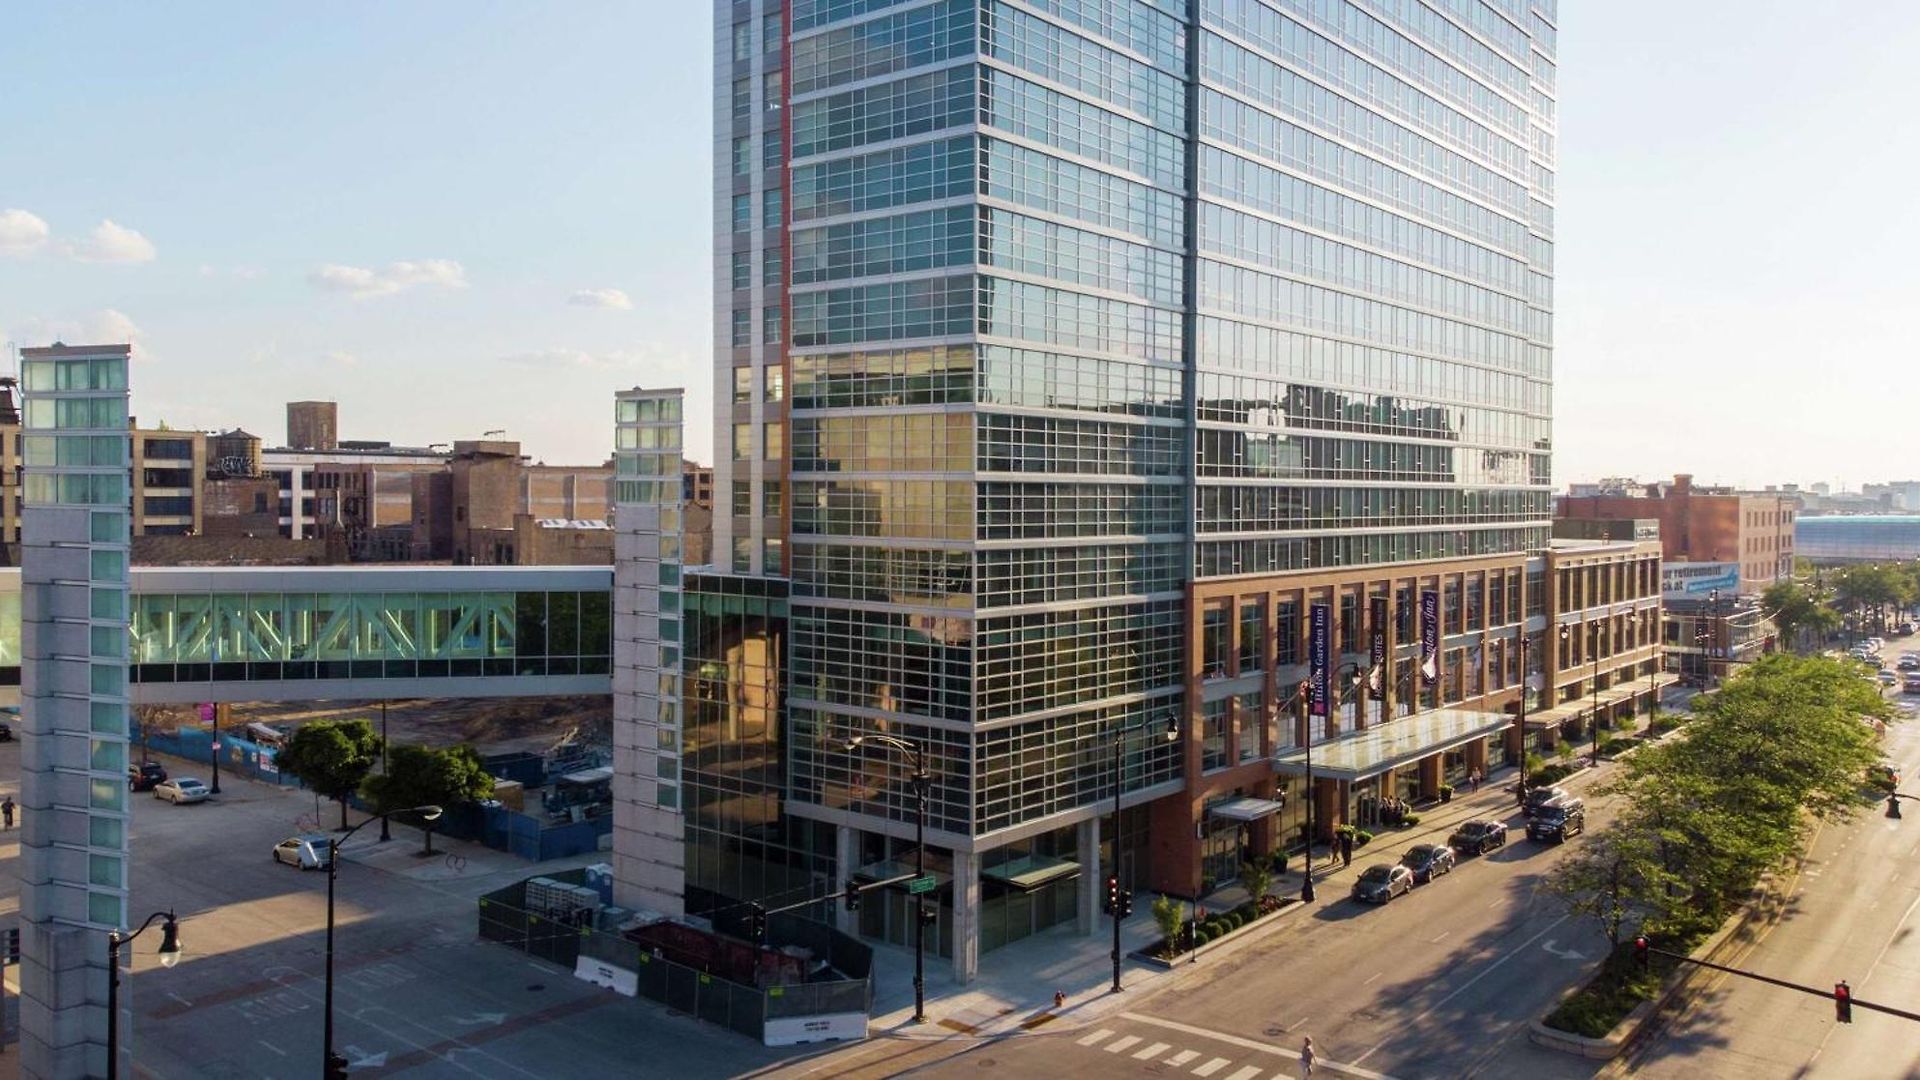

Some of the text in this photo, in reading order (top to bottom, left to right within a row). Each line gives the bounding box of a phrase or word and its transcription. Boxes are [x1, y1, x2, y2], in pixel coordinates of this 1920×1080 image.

[1674, 565, 1721, 578] retirement
[1315, 608, 1324, 627] Inn
[1423, 595, 1436, 624] Inn
[1315, 629, 1324, 666] Garden
